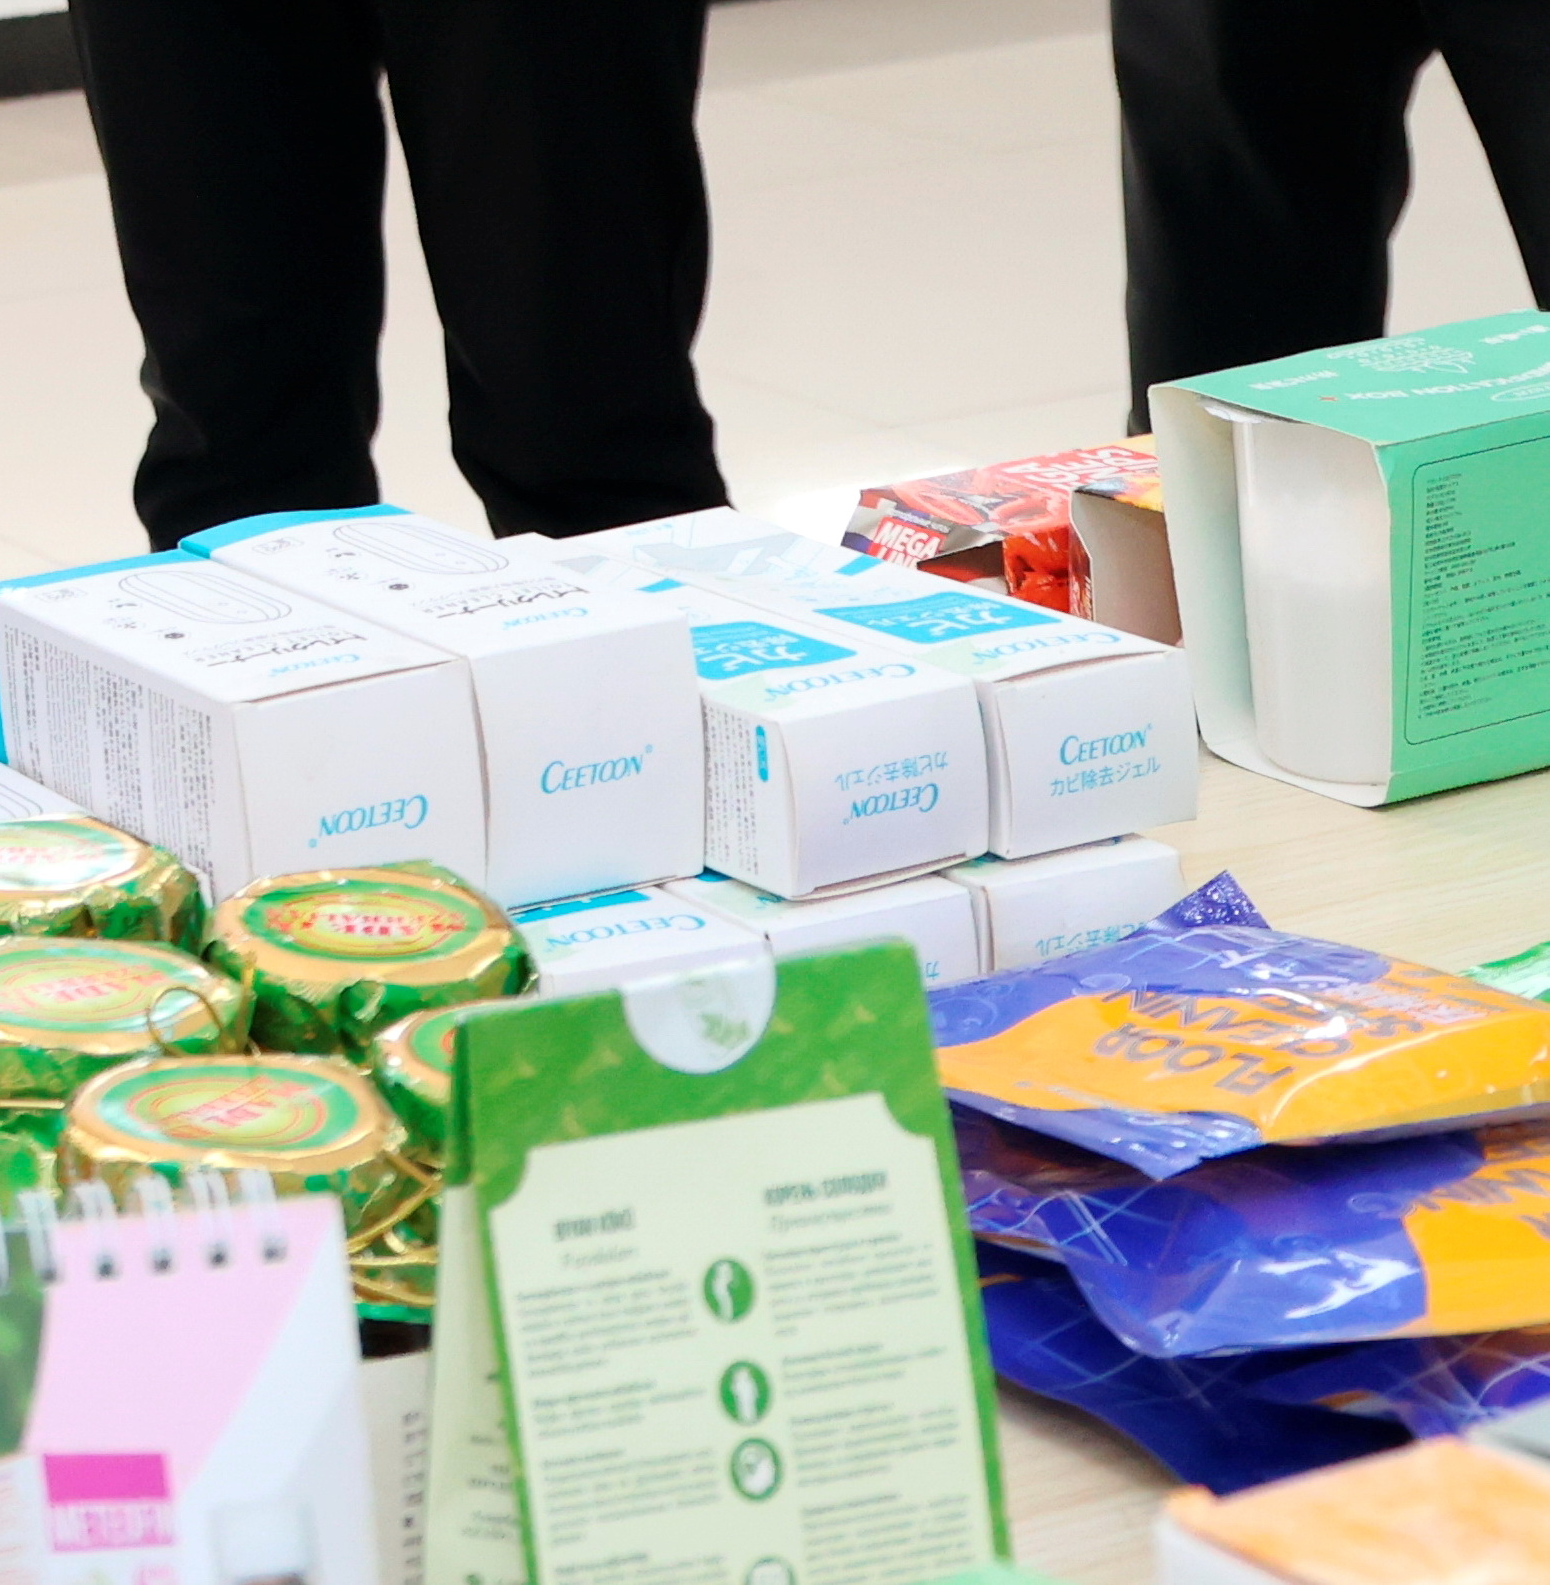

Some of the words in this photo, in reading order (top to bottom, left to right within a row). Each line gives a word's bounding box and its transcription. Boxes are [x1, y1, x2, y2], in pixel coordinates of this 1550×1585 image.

[874, 521, 941, 559] MEGA
[973, 632, 1123, 666] CEETOON
[764, 664, 916, 699] CEETOON
[1060, 731, 1147, 765] CEETOON
[540, 758, 645, 797] CEETOON
[835, 751, 949, 791] カビ除去ジェル
[1050, 756, 1161, 797] カビ除去ジェル
[318, 794, 430, 840] CEETOON
[850, 783, 939, 821] CEETOON
[546, 912, 706, 952] CEETOON
[1094, 1021, 1297, 1095] FLOOR
